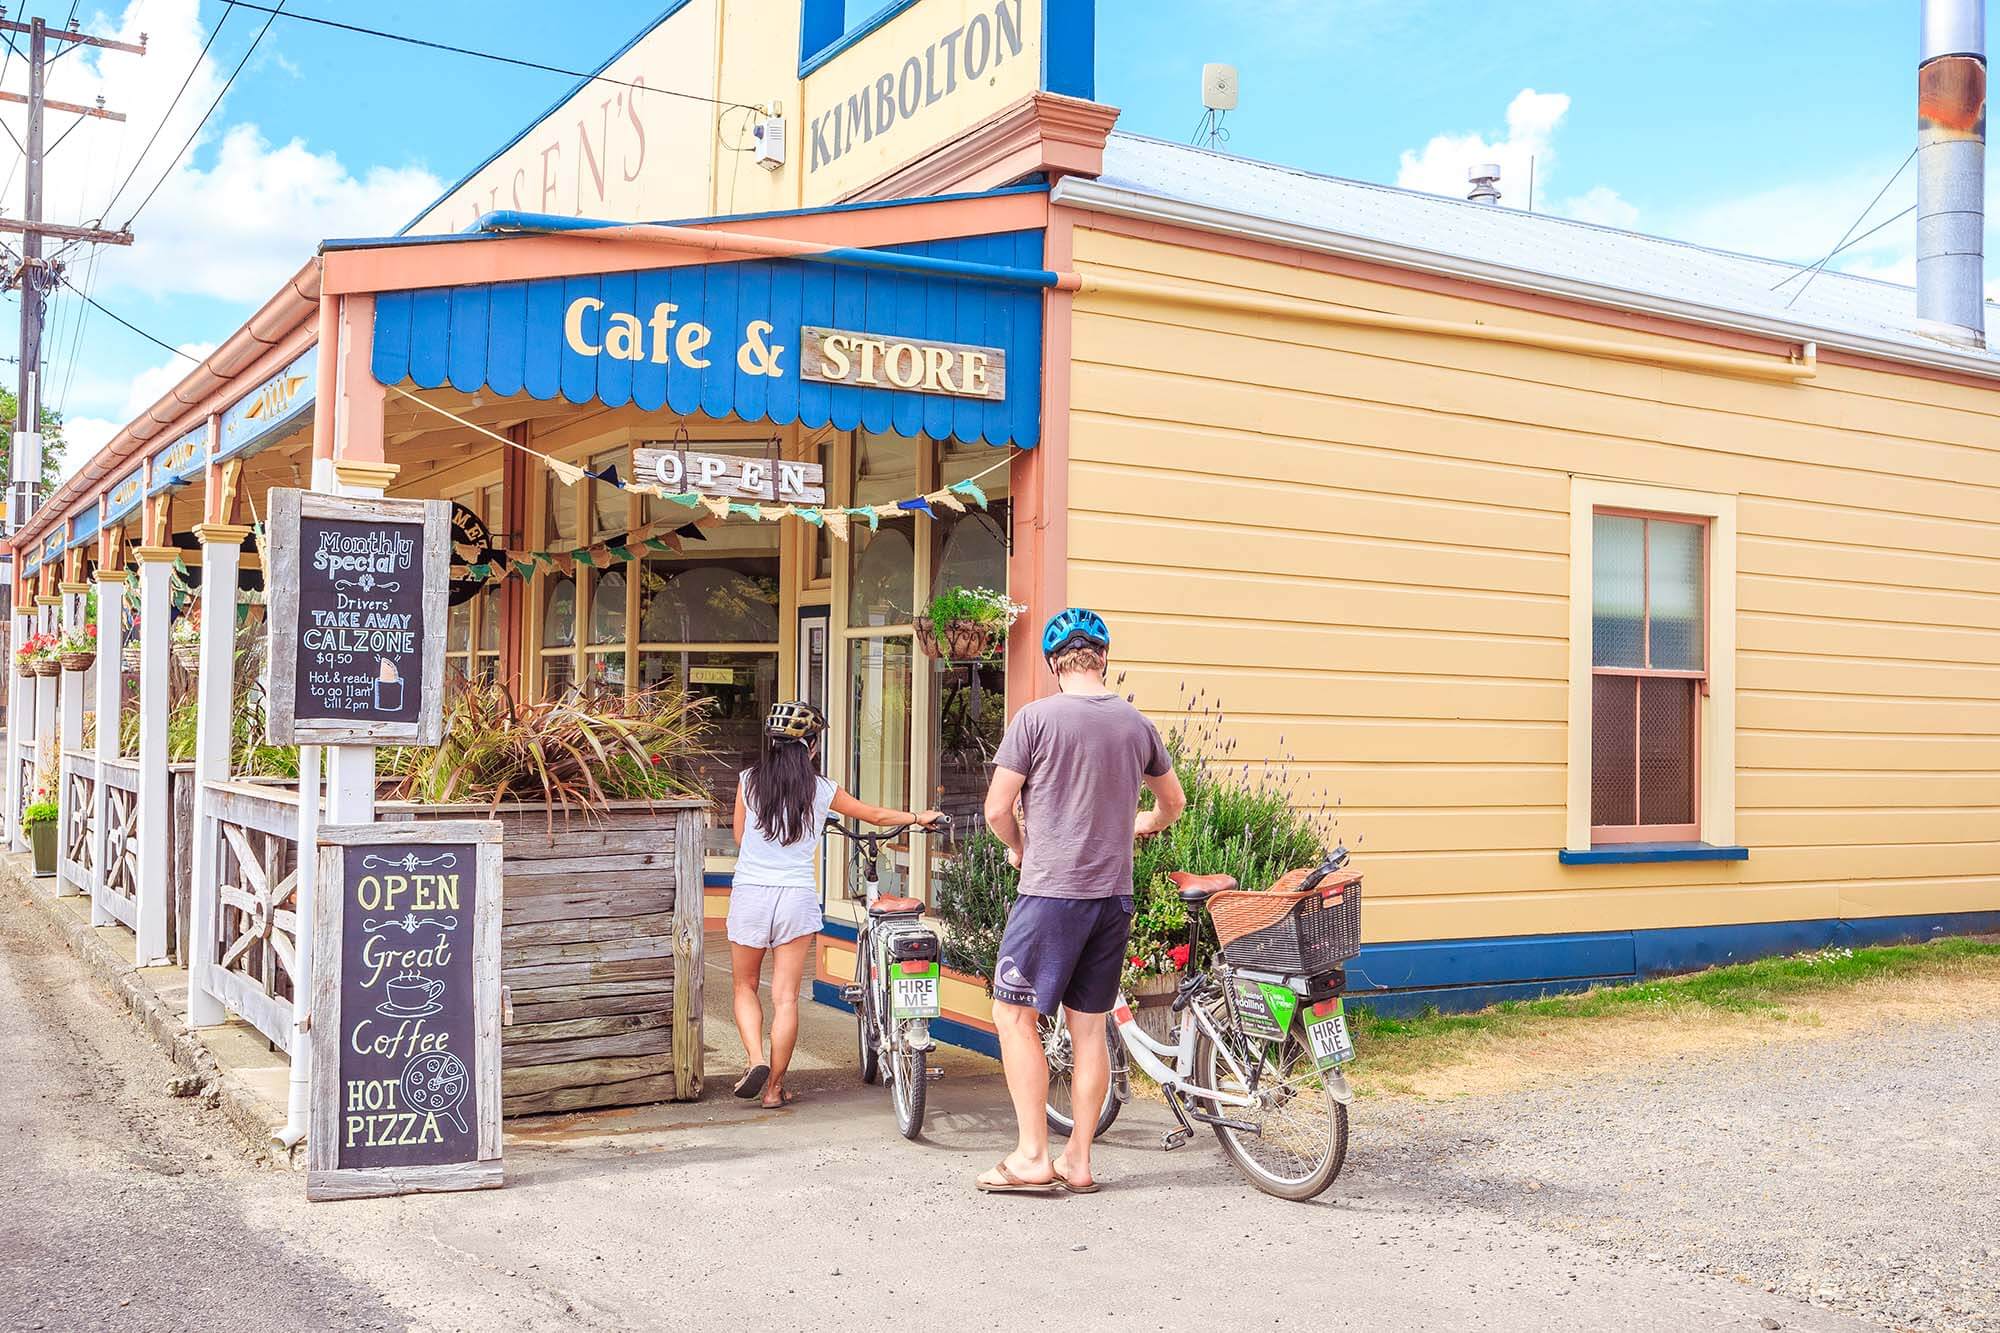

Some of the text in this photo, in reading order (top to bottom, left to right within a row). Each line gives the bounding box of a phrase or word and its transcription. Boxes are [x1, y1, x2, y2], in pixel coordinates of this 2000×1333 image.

[810, 0, 1024, 173] KIMBOLTON
[564, 297, 785, 377] Cafe &
[820, 334, 990, 396] STORE
[656, 455, 806, 495] OPEN
[319, 531, 414, 569] Monthly
[313, 551, 395, 580] Special
[337, 593, 392, 610] Drivers'
[311, 610, 412, 630] TAKE AWAY
[303, 629, 415, 653] CALZONE
[316, 652, 353, 669] $9.50
[309, 671, 374, 691] Hot & ready
[311, 685, 326, 696] to
[328, 687, 343, 702] go
[324, 698, 369, 712] till 2pm
[357, 874, 460, 911] OPEN
[359, 933, 452, 988] Great
[898, 980, 933, 994] HIRE
[904, 993, 928, 1007] ME
[351, 1018, 449, 1059] Coffee
[1313, 1018, 1343, 1040] HIRE
[1321, 1035, 1343, 1054] ME
[347, 1079, 400, 1111] HOT
[346, 1111, 444, 1148] PIZZA
